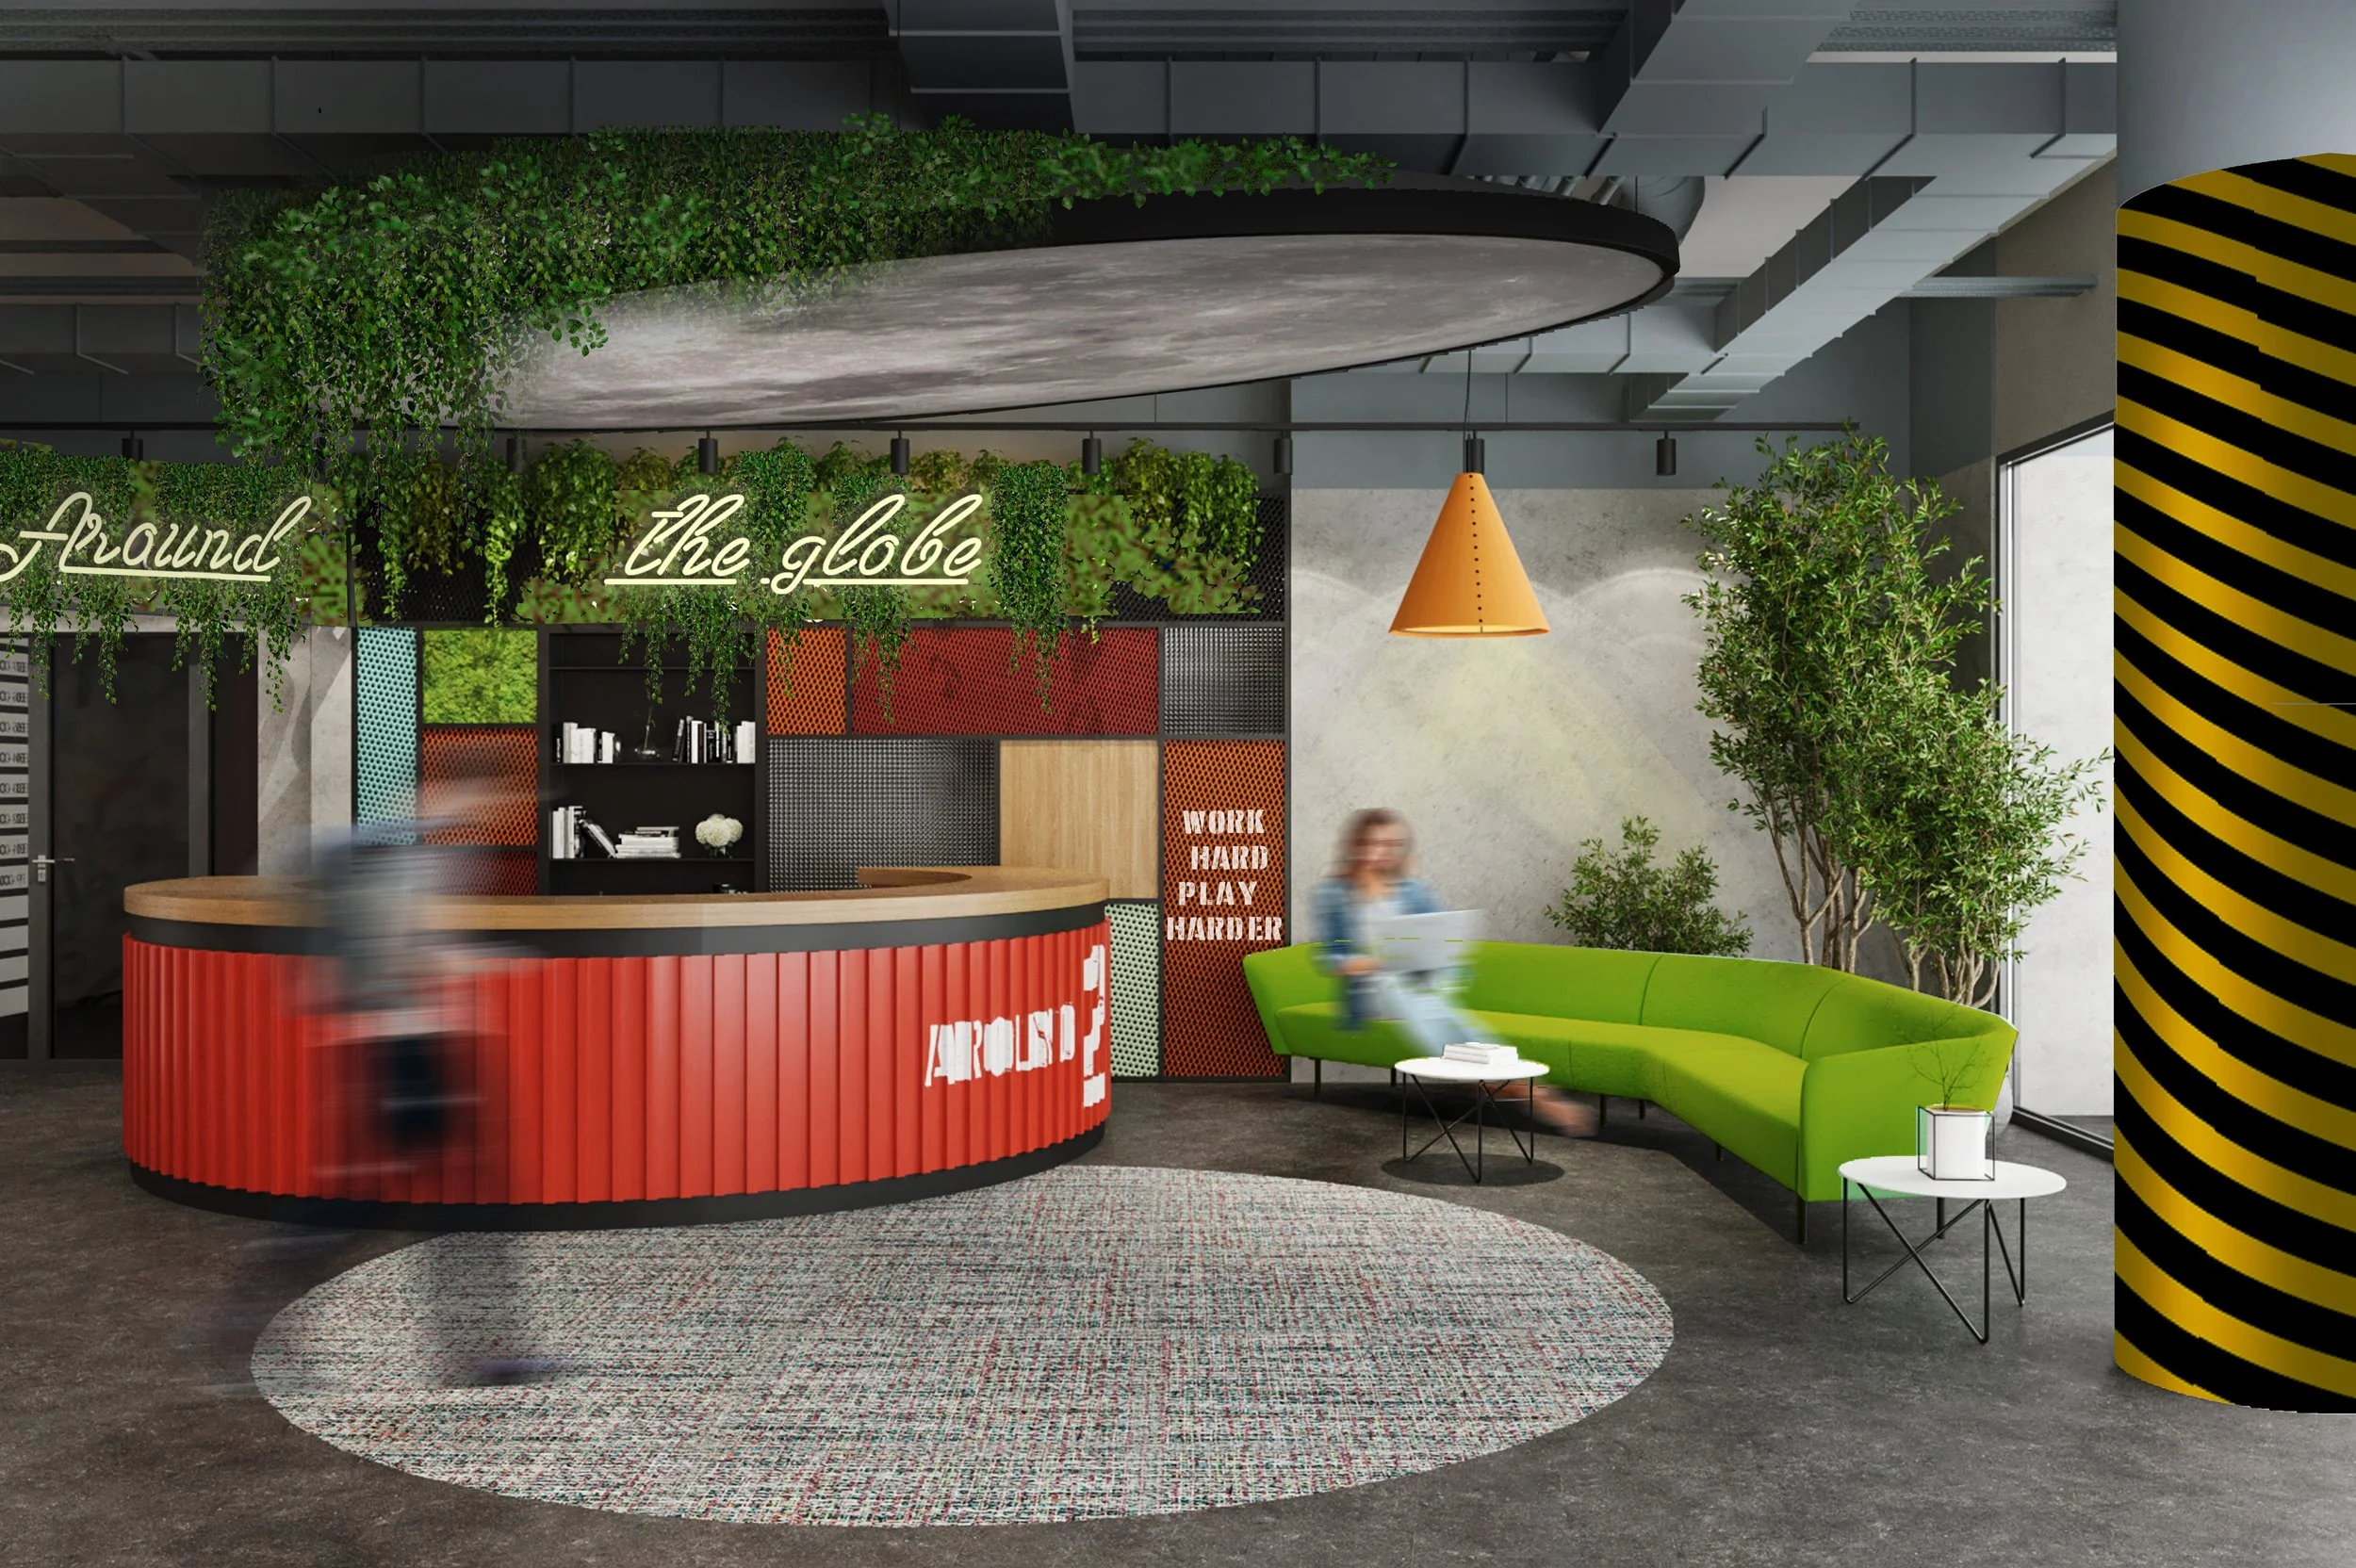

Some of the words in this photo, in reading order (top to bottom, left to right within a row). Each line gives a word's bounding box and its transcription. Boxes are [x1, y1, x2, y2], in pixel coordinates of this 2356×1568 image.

[0, 491, 312, 581] Around
[622, 494, 751, 577] the
[770, 494, 983, 595] globe
[1183, 808, 1266, 834] WORK
[1190, 845, 1269, 871] HARD
[1178, 881, 1258, 906] PLAY
[1167, 916, 1284, 941] HARDER
